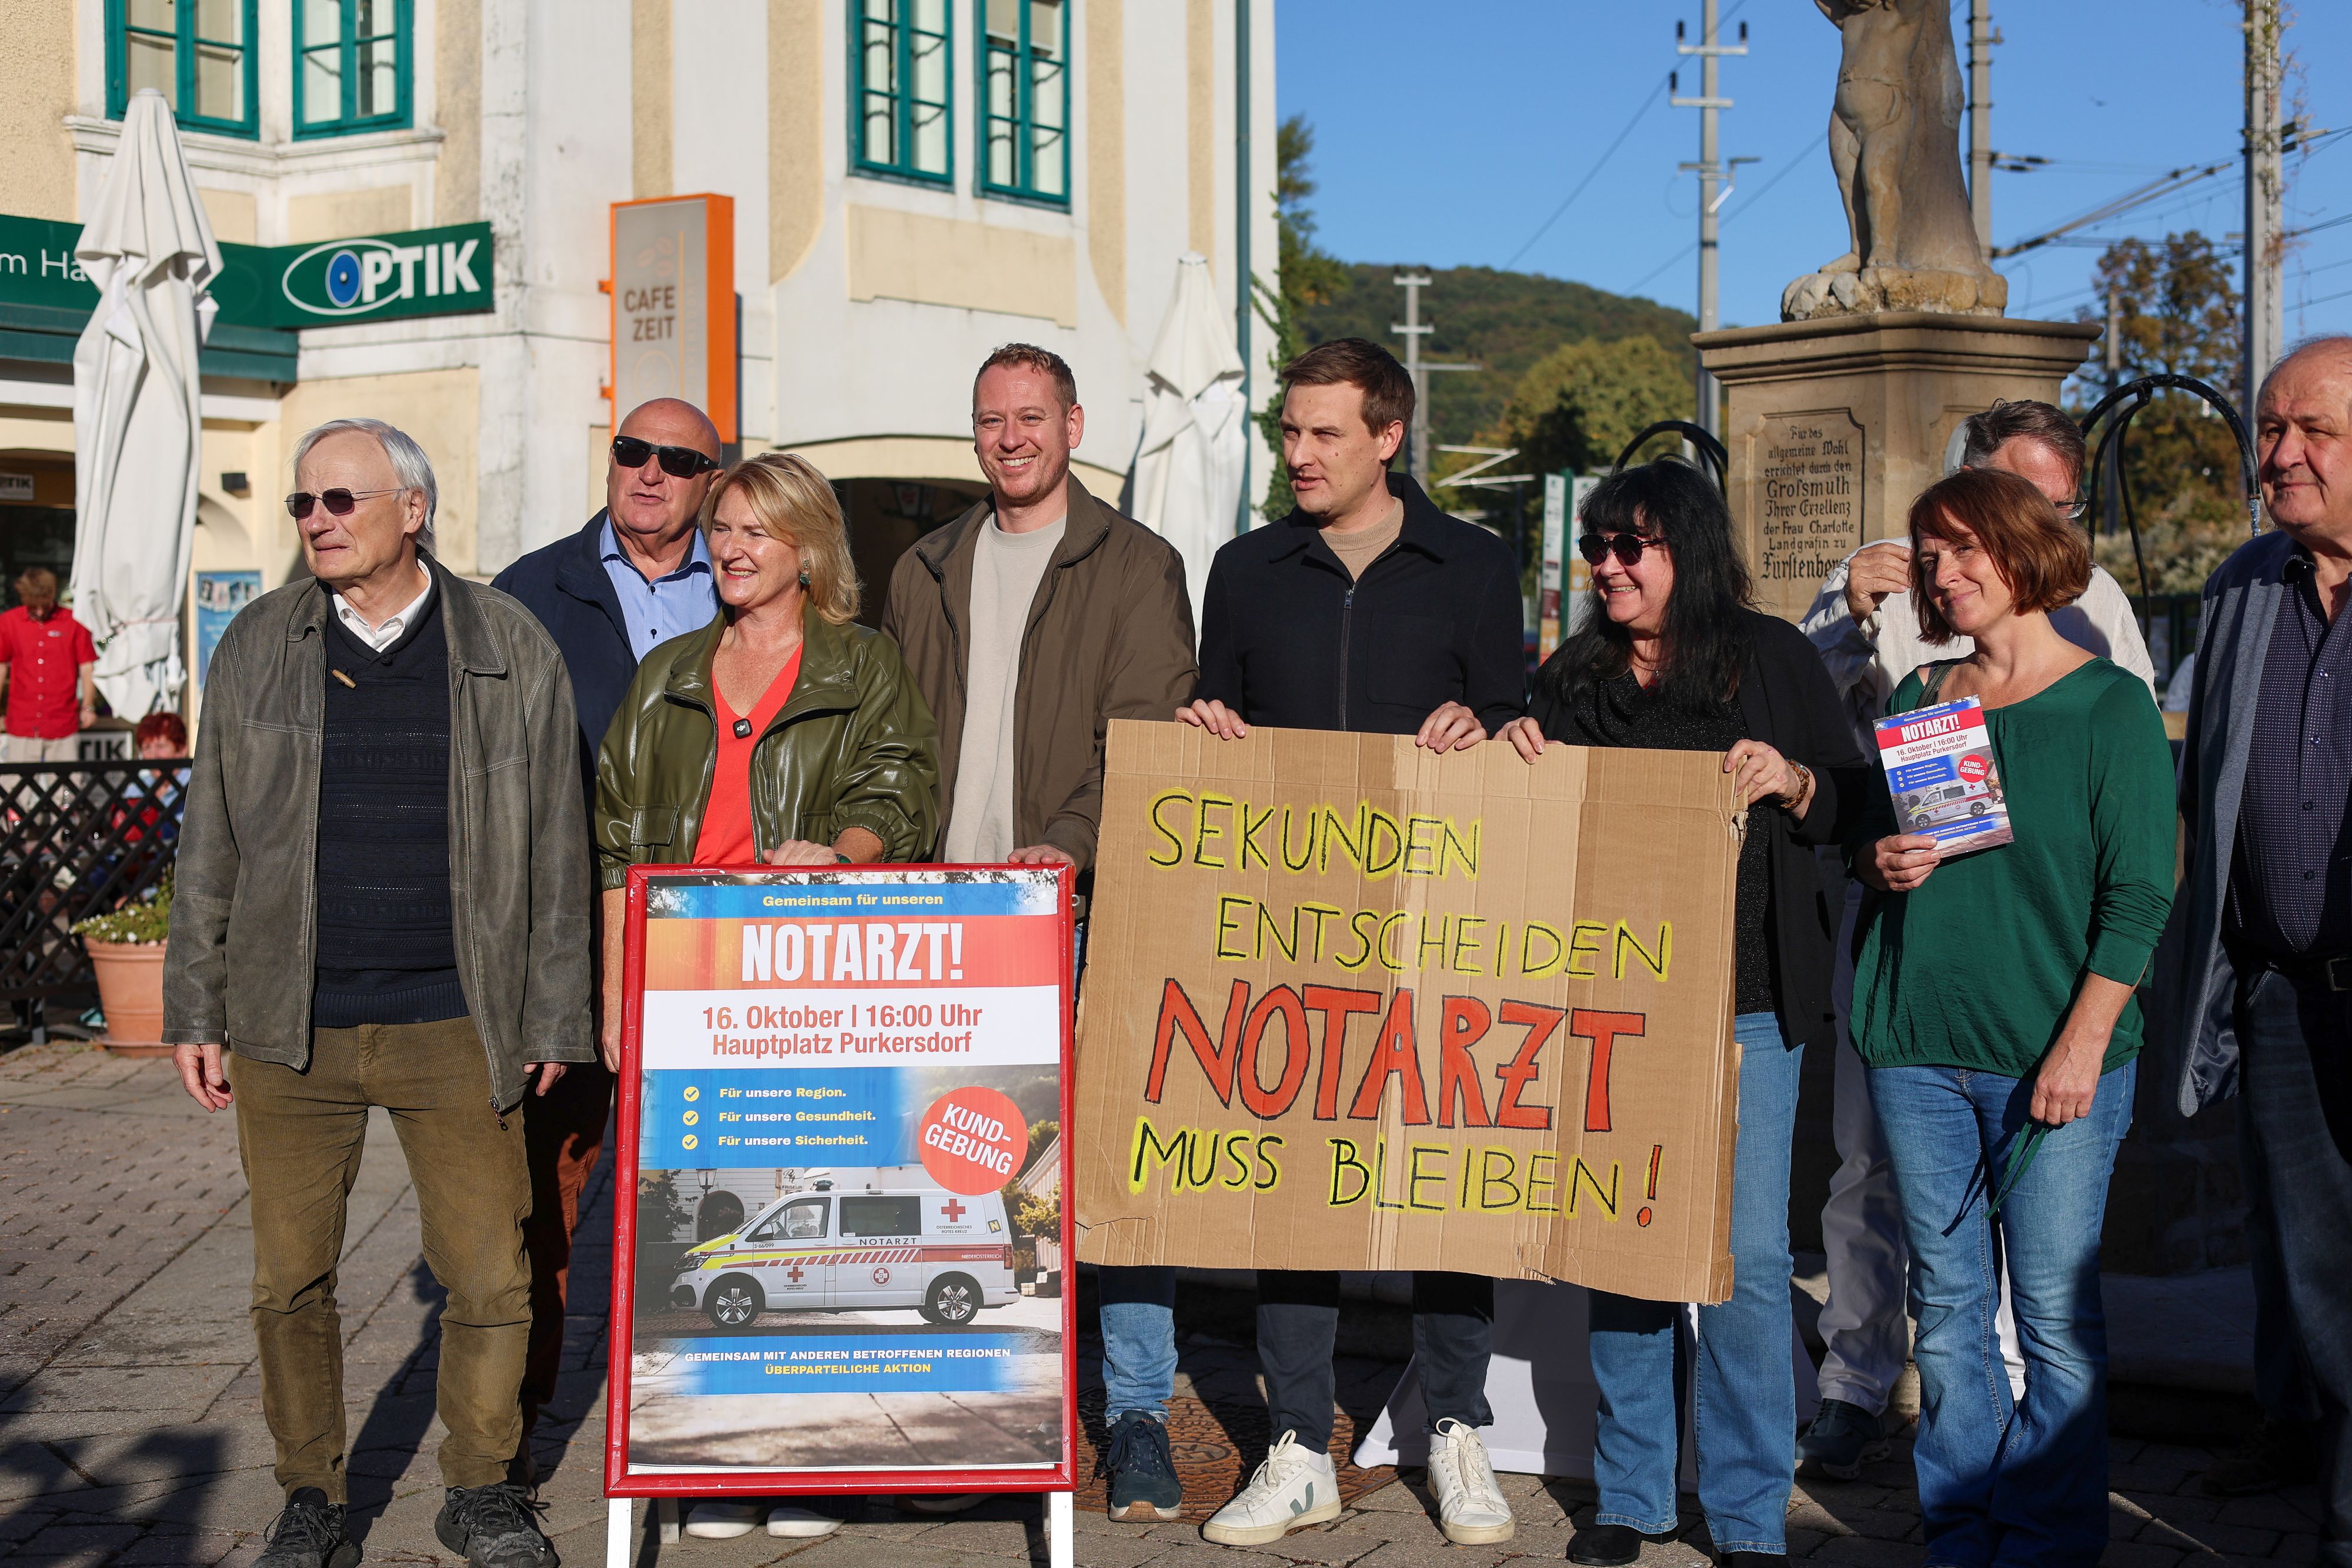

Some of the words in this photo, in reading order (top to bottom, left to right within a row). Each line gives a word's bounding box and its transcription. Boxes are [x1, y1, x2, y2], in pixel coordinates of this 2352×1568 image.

[325, 239, 480, 307] OPTIK
[624, 286, 676, 312] CAFE
[633, 316, 676, 342] ZEIT
[1768, 444, 1816, 462] allgemeine
[1822, 439, 1848, 455] Wohl
[1834, 460, 1852, 472] den
[1765, 500, 1796, 518] Ihrer
[1763, 522, 1779, 534] der
[1783, 521, 1803, 534] Frau
[1809, 520, 1854, 533] Charlotte
[1769, 537, 1829, 554] Landgräfin
[1834, 539, 1846, 548] zu
[1900, 714, 1960, 742] NOTARZT!
[1900, 751, 1932, 763] Hauptplatz
[1933, 741, 1967, 754] Purkersdorf
[1907, 744, 1932, 754] Oktober
[1937, 737, 1955, 746] 16:00
[1960, 766, 1985, 775] GEBUNG
[1963, 760, 1983, 768] KUND-
[1148, 793, 1478, 877] SEKUNDEN
[763, 895, 852, 906] Gemeinsam
[857, 894, 878, 905] für
[882, 895, 943, 905] unseren
[1217, 896, 1667, 979] ENTSCHEIDEN
[741, 922, 964, 982] NOTARZT!
[703, 1006, 738, 1029] 16.
[747, 1005, 843, 1029] Oktober
[866, 1004, 932, 1028] 16:00
[941, 1004, 983, 1027] Uhr
[713, 1033, 832, 1059] Hauptplatz
[840, 1031, 972, 1053] Purkersdorf
[1144, 977, 1646, 1132] NOTARZT
[720, 1088, 742, 1098] Für
[746, 1088, 792, 1098] unsere
[796, 1087, 846, 1099] Region.
[719, 1112, 741, 1122] Für
[745, 1113, 791, 1122] unsere
[796, 1111, 876, 1122] Gesundheit.
[942, 1103, 1011, 1142] KUND-
[718, 1136, 741, 1146] Für
[744, 1136, 791, 1145] unsere
[795, 1135, 868, 1145] Sicherheit.
[925, 1124, 1013, 1175] GEBUNG
[1133, 1122, 1284, 1190] MUSS
[859, 1238, 917, 1246] NOTARZT
[684, 1352, 760, 1362] GEMEINSAM
[764, 1351, 787, 1360] MIT
[790, 1350, 849, 1360] ANDEREN
[853, 1349, 943, 1359] BETROFFENEN
[947, 1348, 1011, 1358] REGIONEN
[765, 1363, 880, 1375] ÜBERPARTEILICHE
[883, 1363, 931, 1373] AKTION
